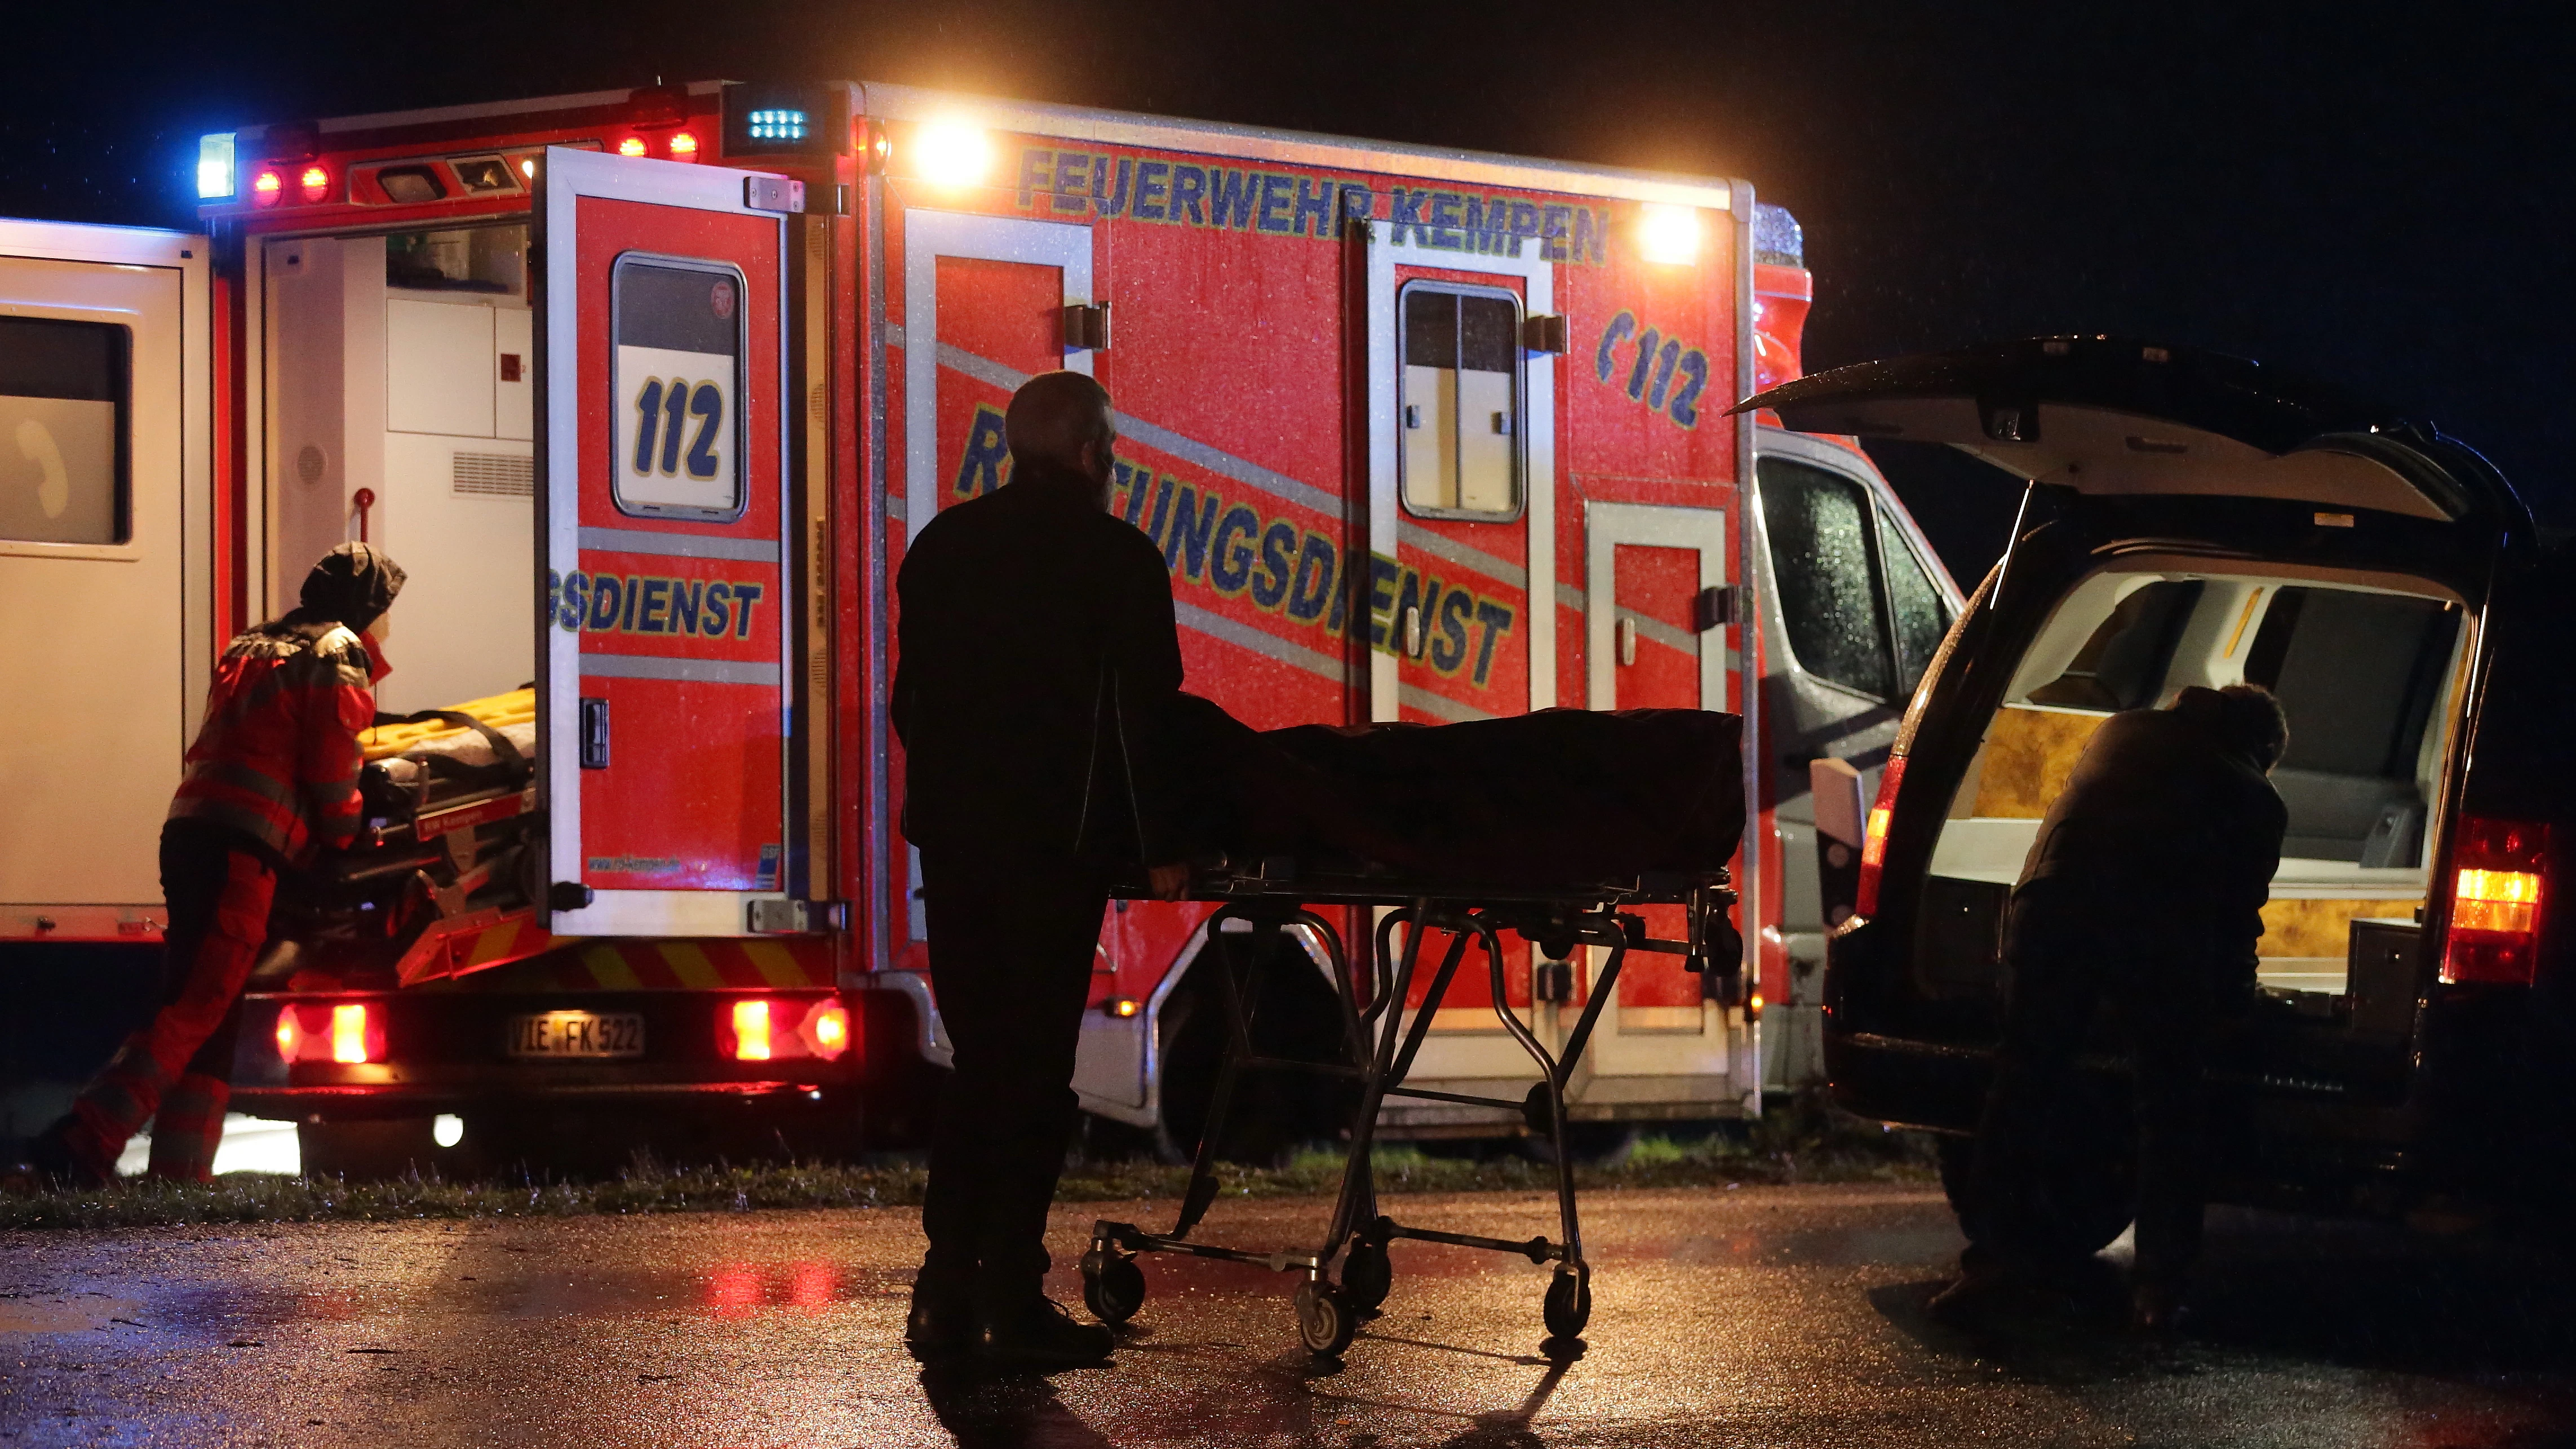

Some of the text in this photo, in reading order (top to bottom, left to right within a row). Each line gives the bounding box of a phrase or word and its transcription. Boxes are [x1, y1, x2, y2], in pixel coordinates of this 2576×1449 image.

[1016, 144, 1611, 268] FEUERWEHR KEMPEN
[631, 375, 725, 482] 112
[1625, 324, 1710, 431] 112
[512, 1017, 637, 1052] VIE FK 522
